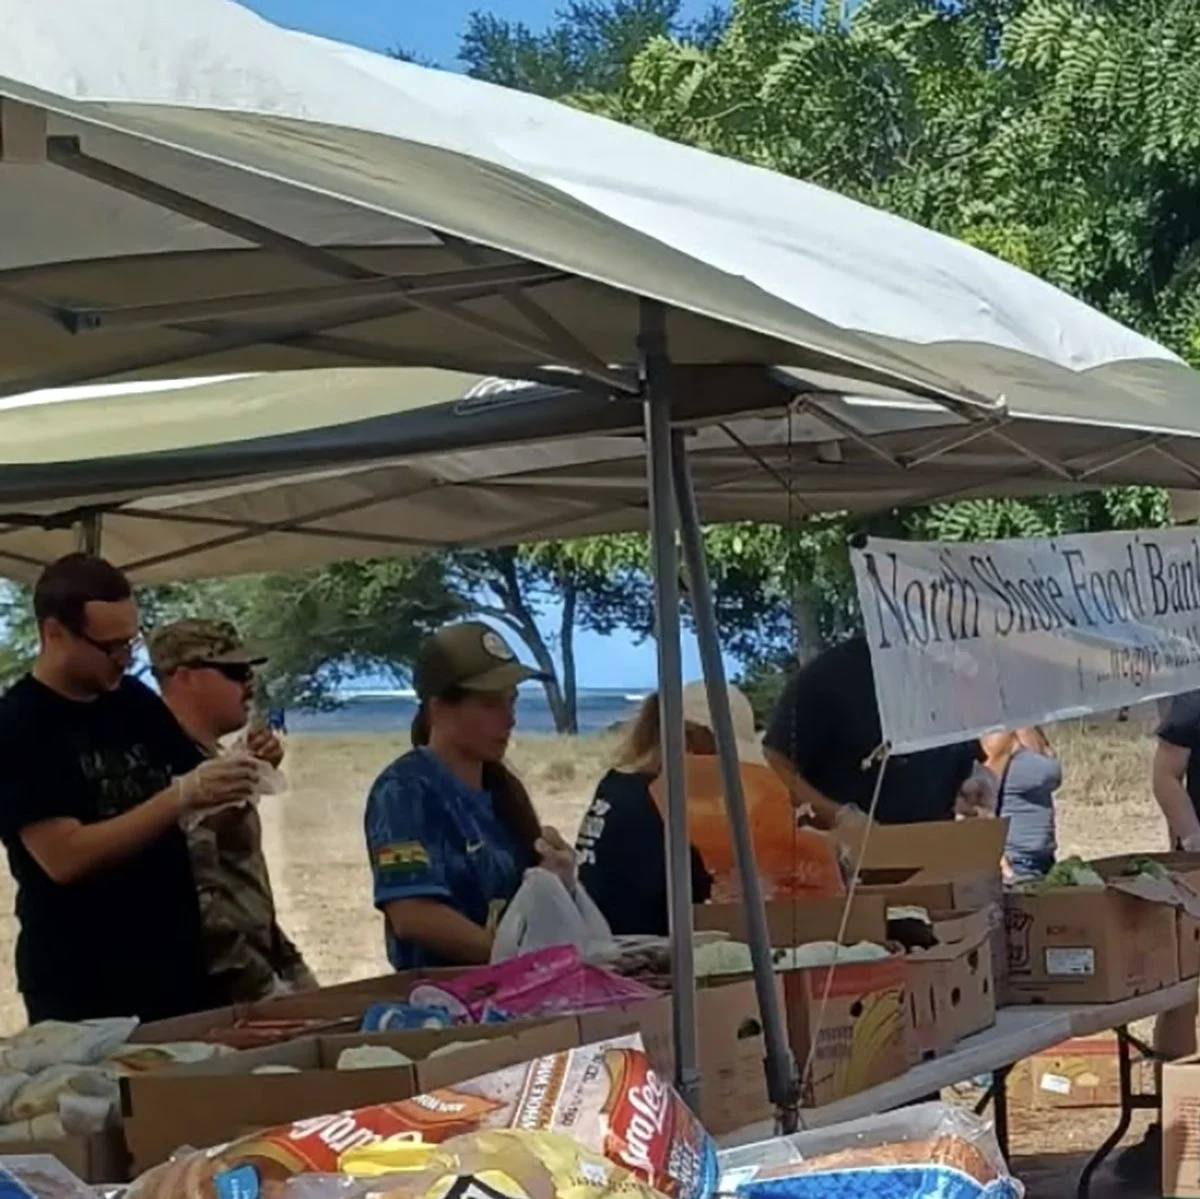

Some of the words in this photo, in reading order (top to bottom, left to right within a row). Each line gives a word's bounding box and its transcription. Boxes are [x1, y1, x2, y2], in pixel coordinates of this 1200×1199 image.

[863, 549, 981, 648] North
[970, 553, 1076, 636] Shore
[1061, 538, 1146, 626] Food
